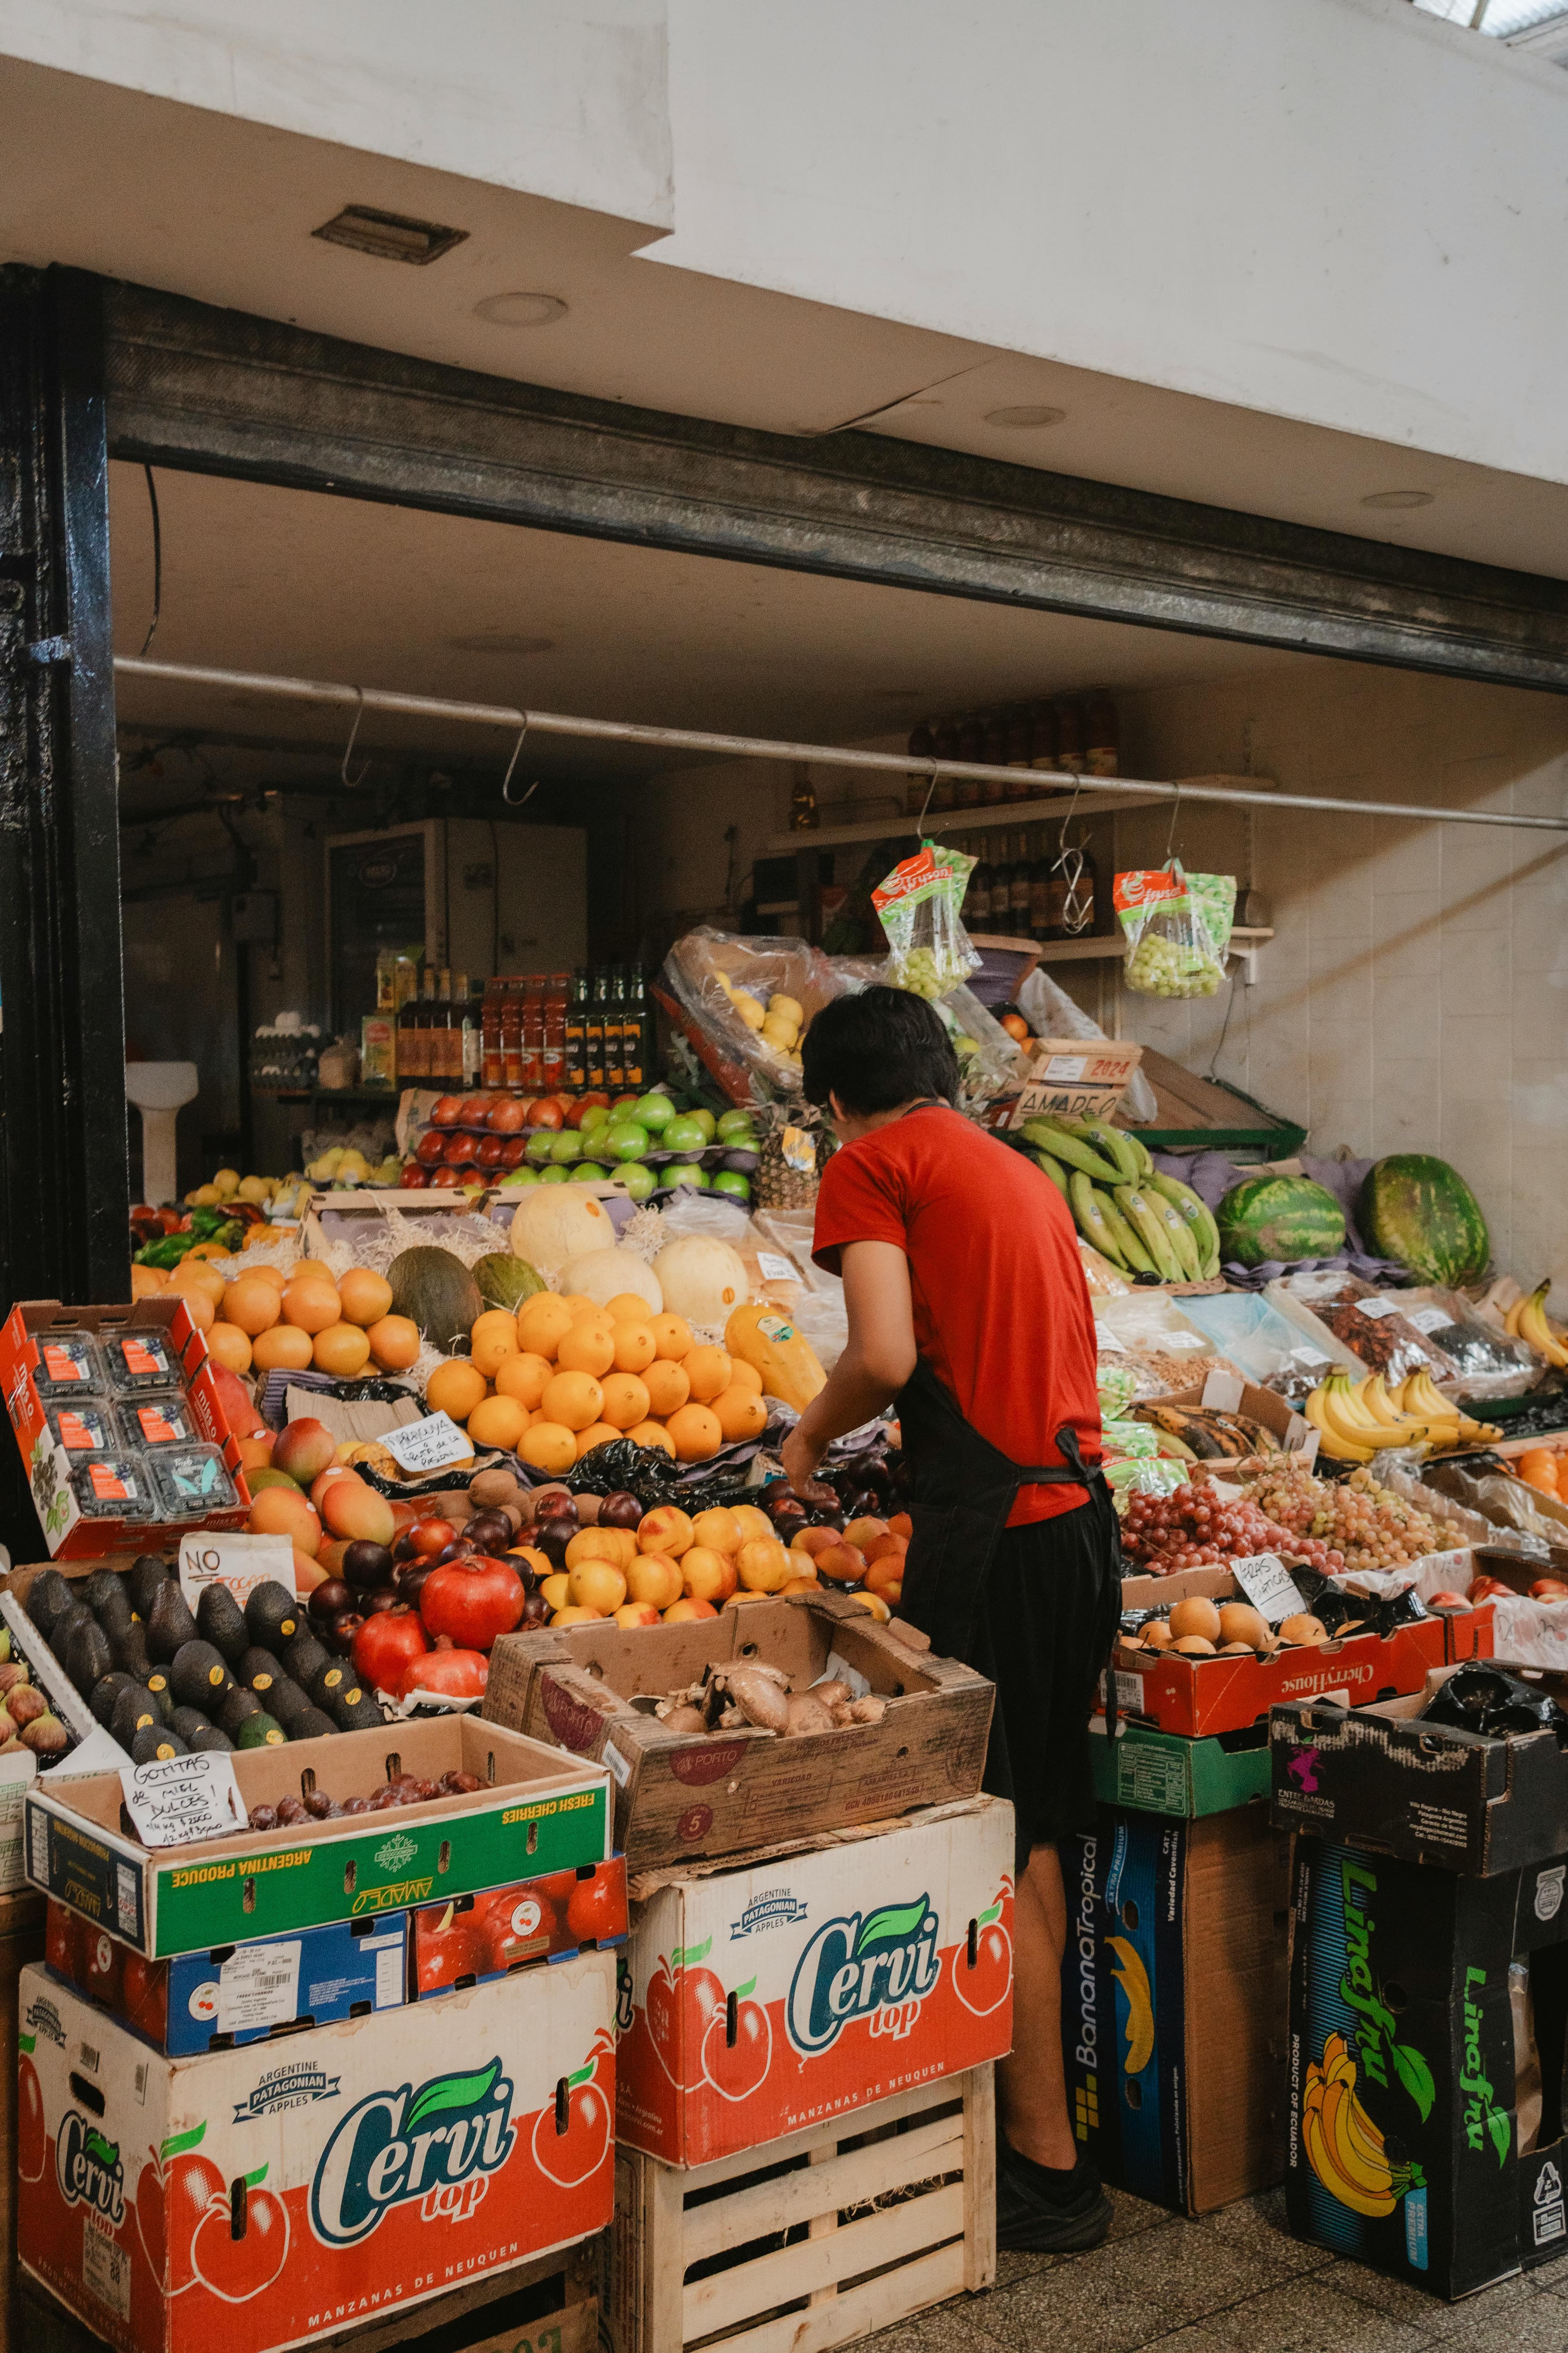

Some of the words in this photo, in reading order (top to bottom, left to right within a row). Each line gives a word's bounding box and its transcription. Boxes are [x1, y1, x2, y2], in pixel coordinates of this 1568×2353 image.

[905, 867, 949, 895] fryson
[1091, 1059, 1131, 1076] 2024
[1021, 1093, 1116, 1118] AMADEO
[19, 1362, 29, 1404] mss
[198, 1389, 213, 1426] miss
[211, 1426, 216, 1438] o
[185, 1550, 220, 1573] NO
[1281, 1664, 1374, 1693] CherryHouse
[134, 1754, 209, 1785] GOTITAS
[695, 1750, 737, 1766] PORTO
[772, 1773, 811, 1786] VARIEDAD
[133, 1791, 150, 1804] de
[502, 1800, 557, 1825] CHERRIES
[559, 1793, 595, 1809] FRESH
[688, 1815, 700, 1832] 5
[1418, 1810, 1442, 1820] Patagonia
[1443, 1816, 1467, 1825] Argentina
[239, 1850, 312, 1875] ARGENTINA
[1113, 1826, 1124, 1871] PREMIUM
[1168, 1831, 1179, 1878] Cavendish
[172, 1862, 235, 1888] PRODUCE
[1109, 1873, 1118, 1903] EXTRA
[352, 1878, 433, 1914] AMADEO
[748, 1888, 791, 1909] ARGENTINE
[1168, 1881, 1176, 1922] Variedad
[743, 1901, 796, 1922] PATAGONIAN
[755, 1917, 784, 1934] APPLES
[1076, 1834, 1098, 2069] BananaTropical
[791, 1914, 938, 2050] Cervi
[1341, 1857, 1396, 2089] Linafru
[870, 2001, 920, 2040] top
[1291, 2034, 1300, 2090] PRODUCT
[1459, 1965, 1496, 2151] Linafru
[258, 2061, 318, 2086] ARGENTINE
[253, 2075, 324, 2103] PATAGONIAN
[788, 2092, 858, 2125] MANZANAS
[866, 2084, 881, 2096] DE
[889, 2062, 944, 2089] NEUQUEN
[1291, 2092, 1299, 2108] OF
[269, 2095, 307, 2114] APPLES
[1290, 2110, 1298, 2168] ECUADOR
[58, 2112, 124, 2224] Cervi
[310, 2079, 513, 2244] Cervi
[422, 2176, 489, 2223] top
[1408, 2201, 1417, 2262] PREMIUM
[1416, 2204, 1424, 2237] EXTRA
[308, 2284, 403, 2327] MANZANAS
[414, 2273, 434, 2289] DE
[445, 2242, 518, 2277] NEUQUEN
